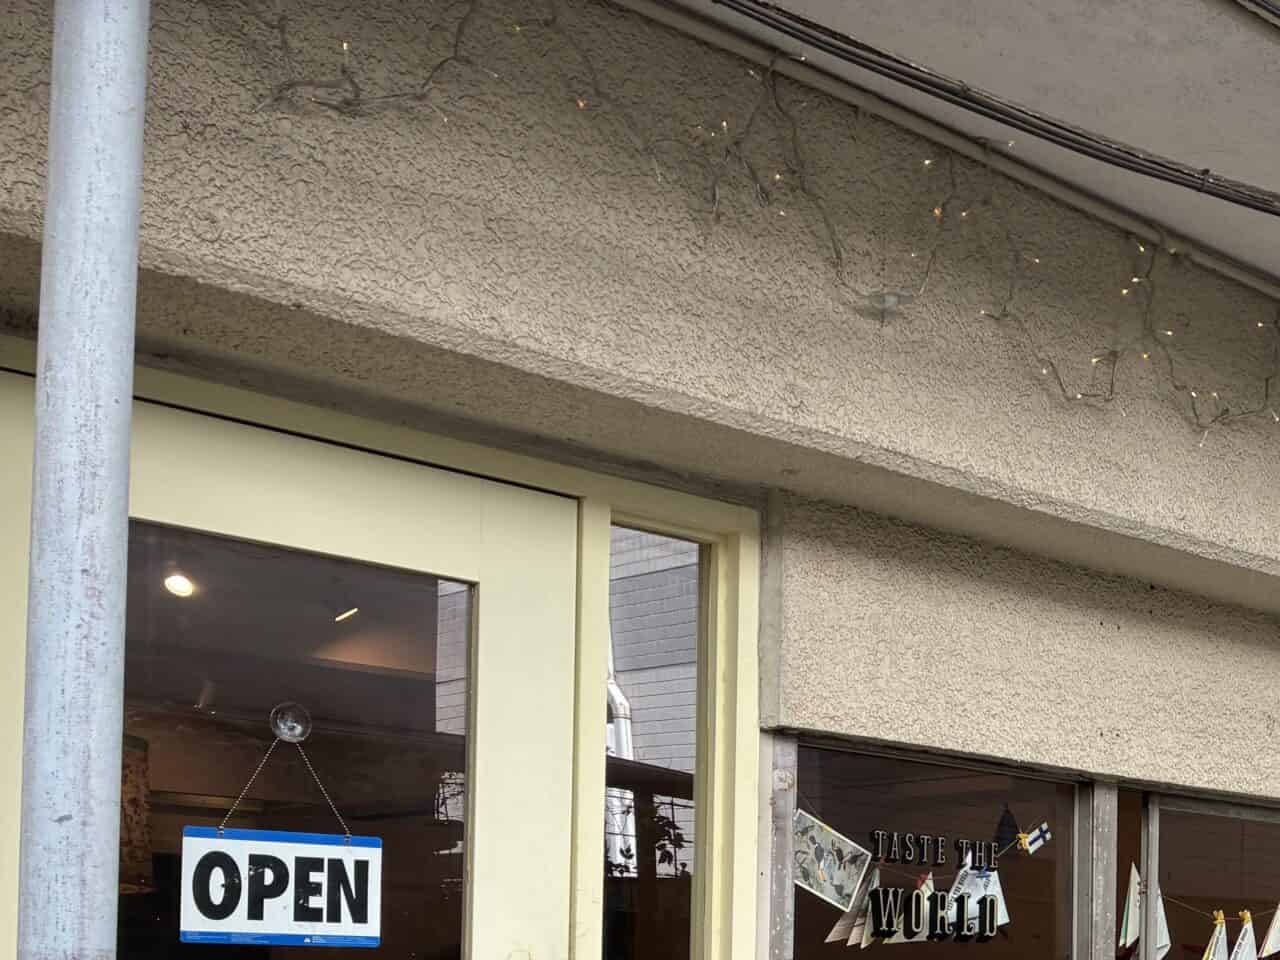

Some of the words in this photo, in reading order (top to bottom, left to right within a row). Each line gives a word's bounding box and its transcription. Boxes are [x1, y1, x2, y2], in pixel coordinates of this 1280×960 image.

[873, 830, 946, 862] TASTE
[958, 839, 1000, 868] THE
[192, 850, 370, 924] OPEN
[871, 887, 1000, 939] WORLD
